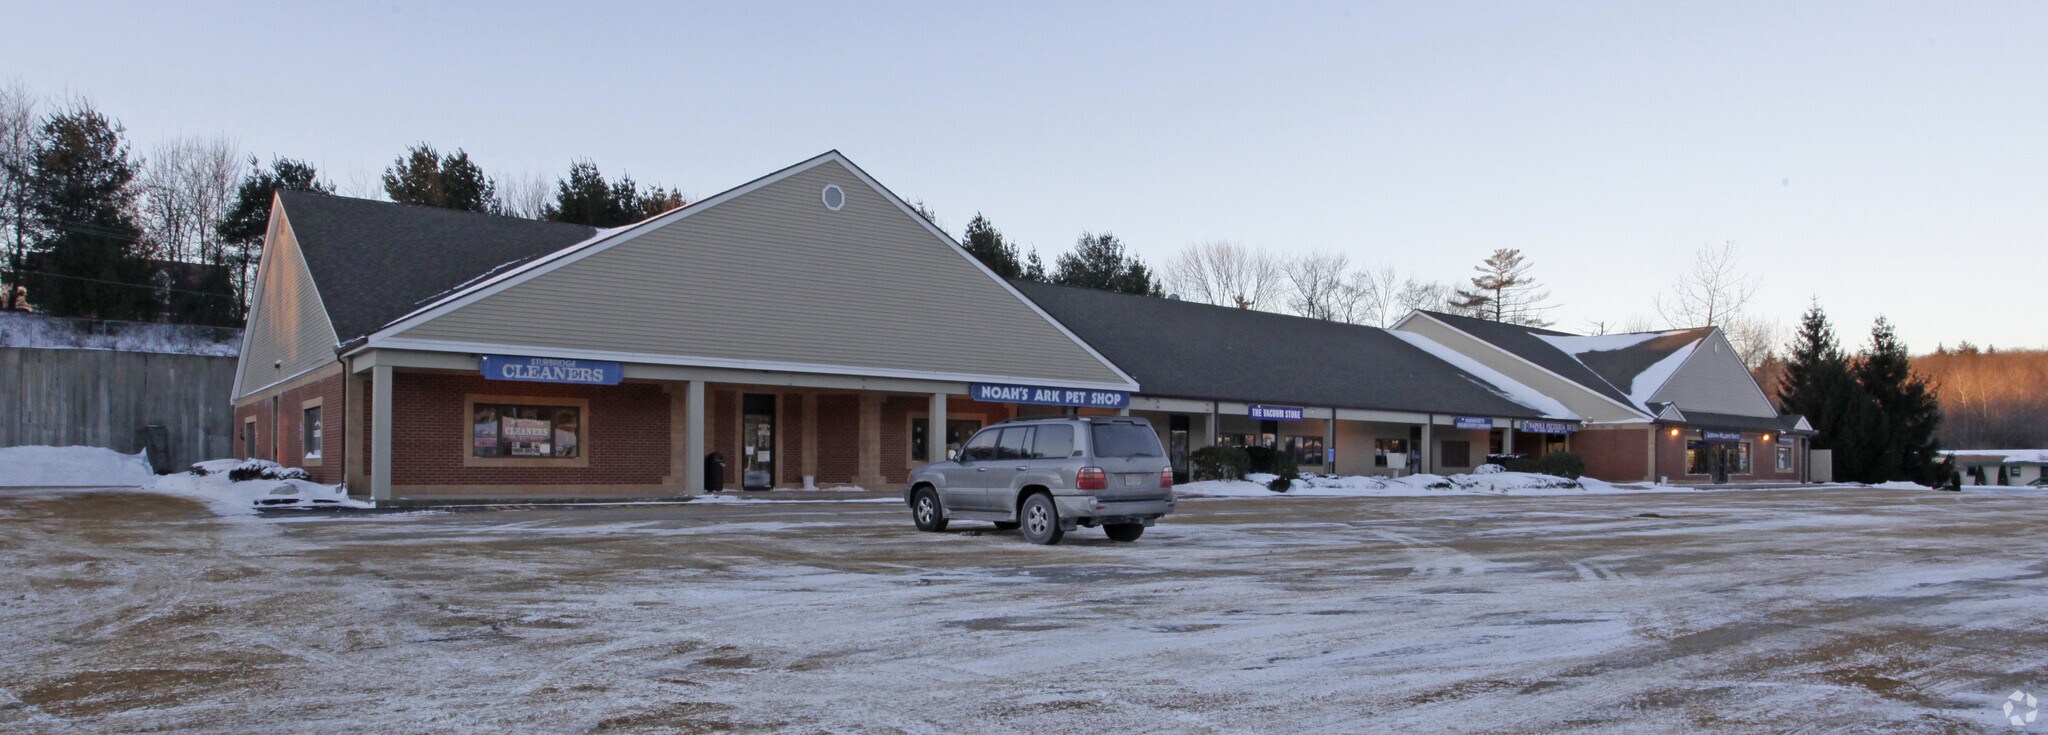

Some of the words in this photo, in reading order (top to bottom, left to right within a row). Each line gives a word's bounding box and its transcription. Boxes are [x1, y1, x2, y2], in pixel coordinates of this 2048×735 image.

[530, 358, 576, 368] STURBRIDGE
[502, 364, 604, 382] CLEANERS
[981, 385, 1029, 401] NOAH'S
[1034, 389, 1060, 402] ARK
[1065, 391, 1086, 404] PET
[1091, 392, 1121, 405] SHOP
[1252, 408, 1262, 417] THE
[1263, 409, 1284, 418] VACUUM
[1285, 410, 1301, 419] STORE
[505, 427, 549, 436] CLEANERS
